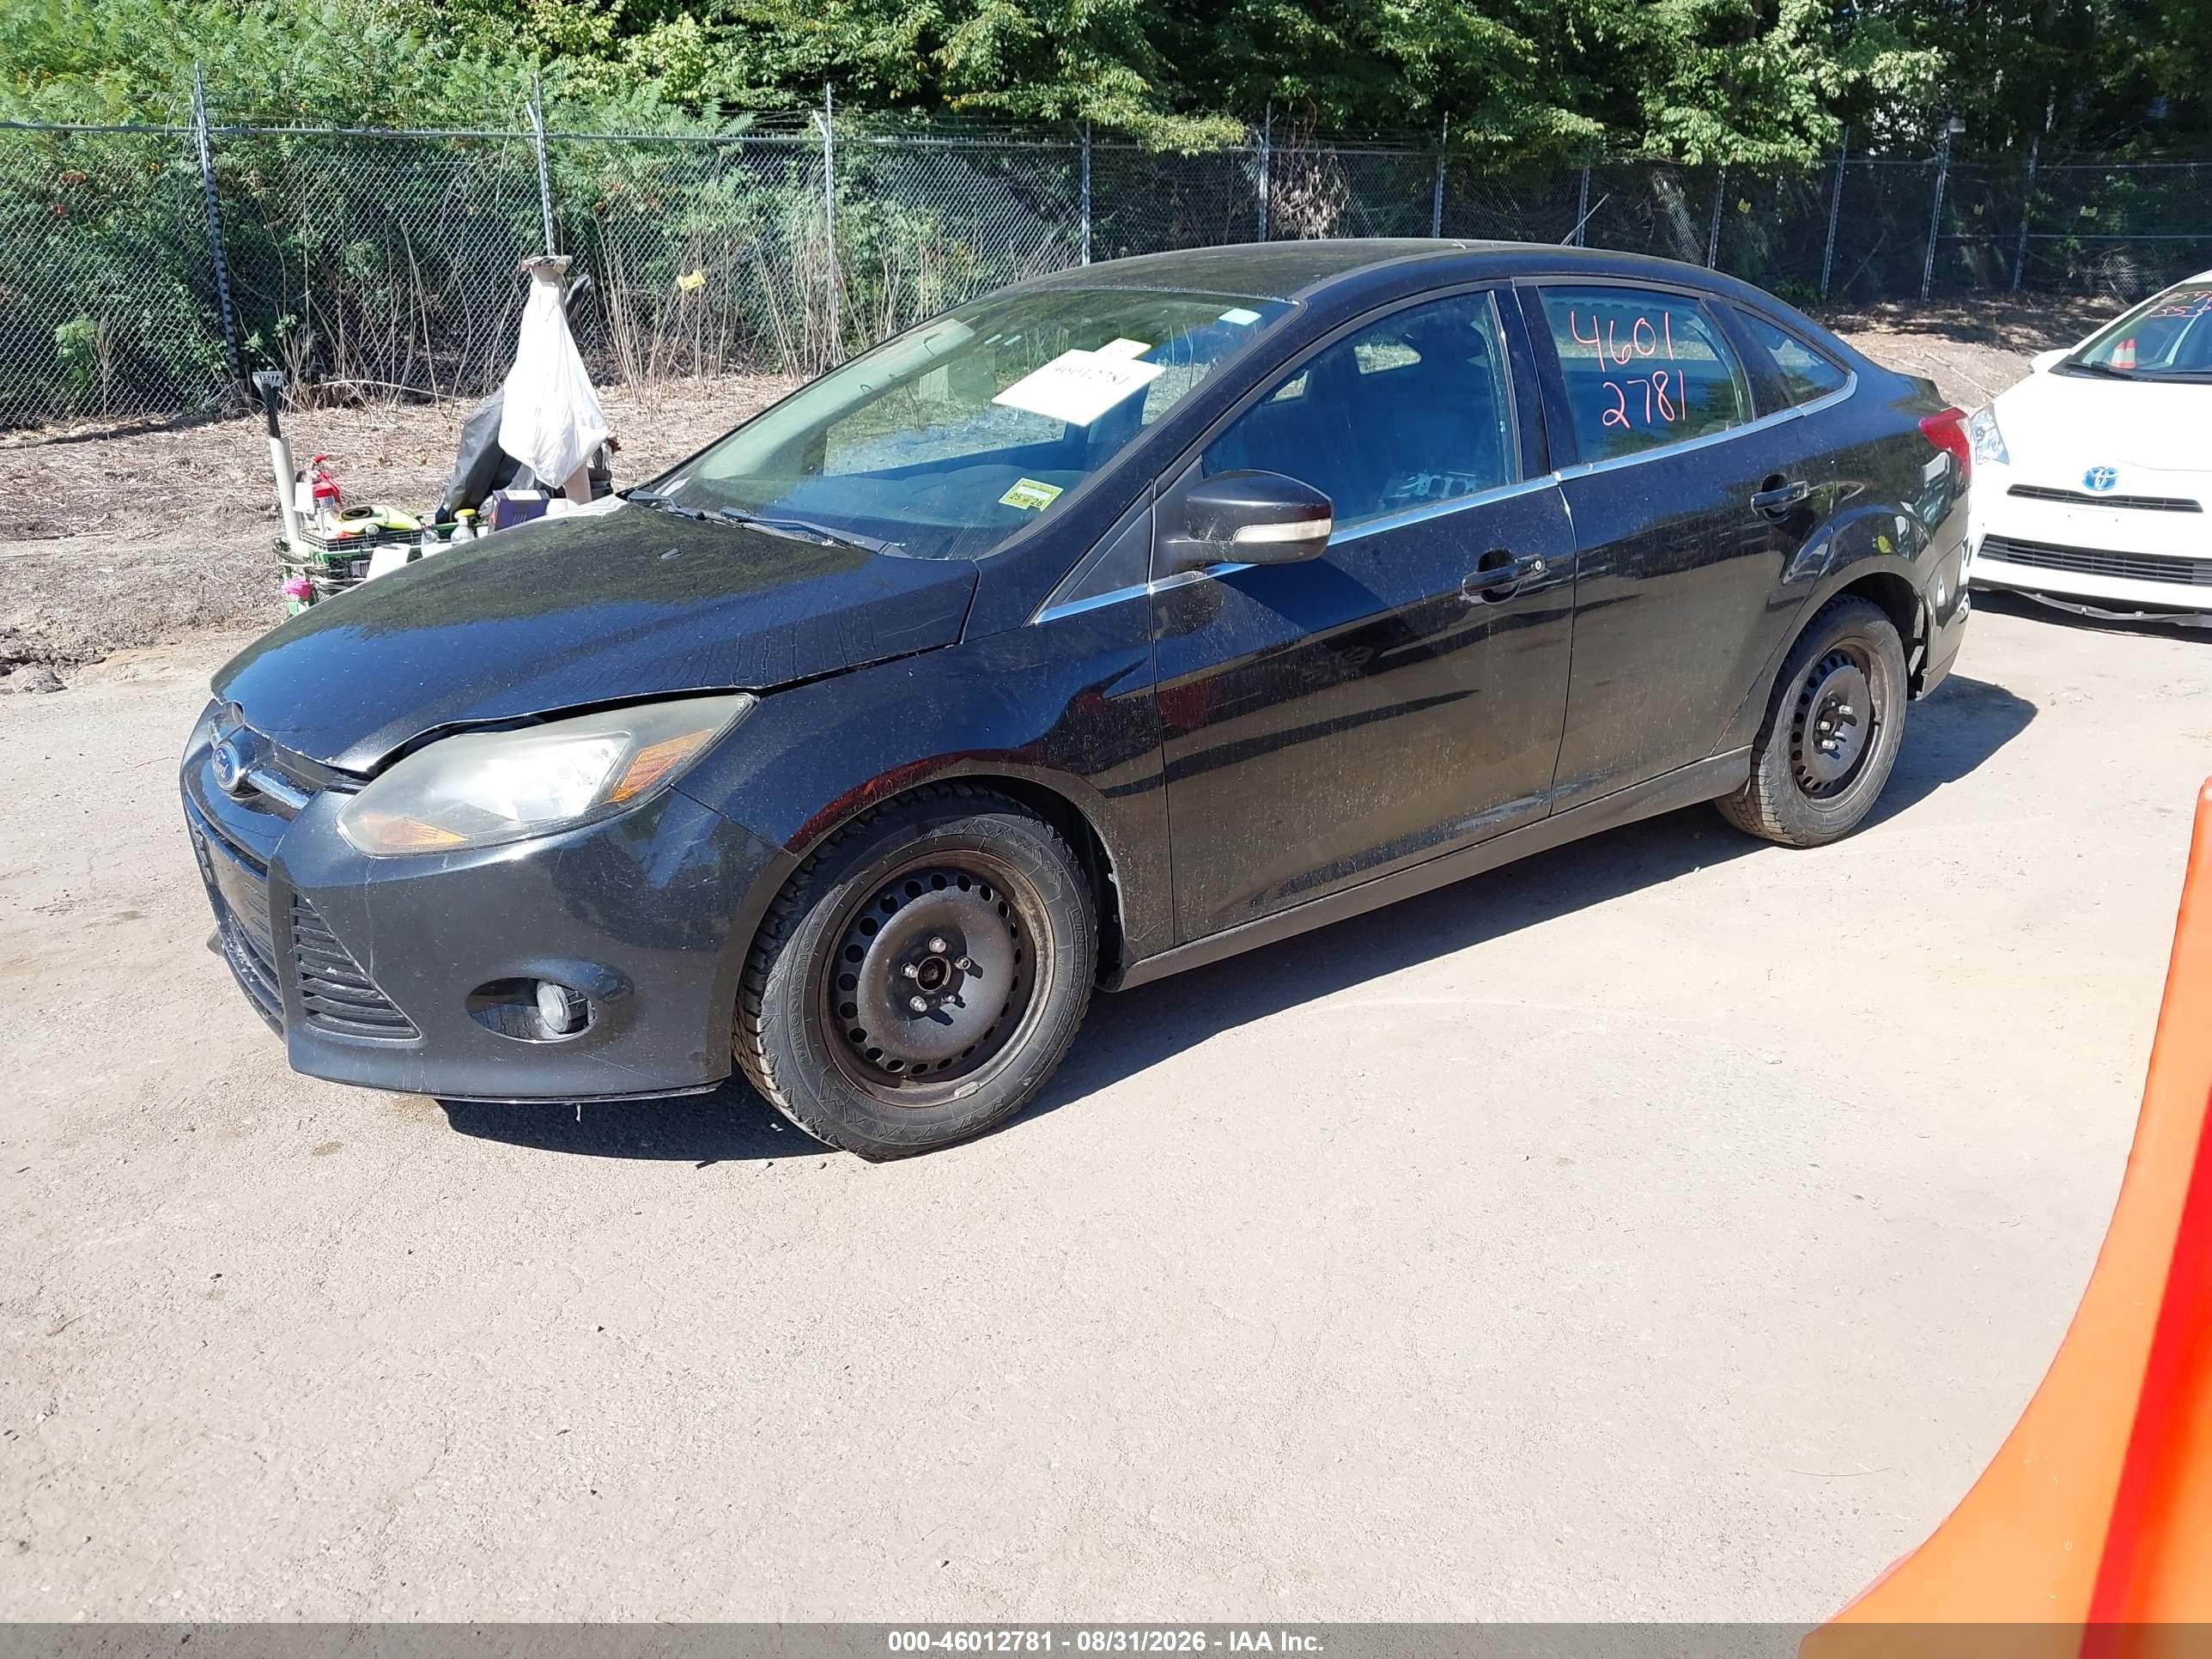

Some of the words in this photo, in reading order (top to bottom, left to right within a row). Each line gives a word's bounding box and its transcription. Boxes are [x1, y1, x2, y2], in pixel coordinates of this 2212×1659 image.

[1571, 310, 1674, 373] 4601
[1601, 368, 1686, 428] 2781
[1009, 492, 1024, 501] 25
[1030, 498, 1044, 507] 26
[215, 749, 229, 779] Ford
